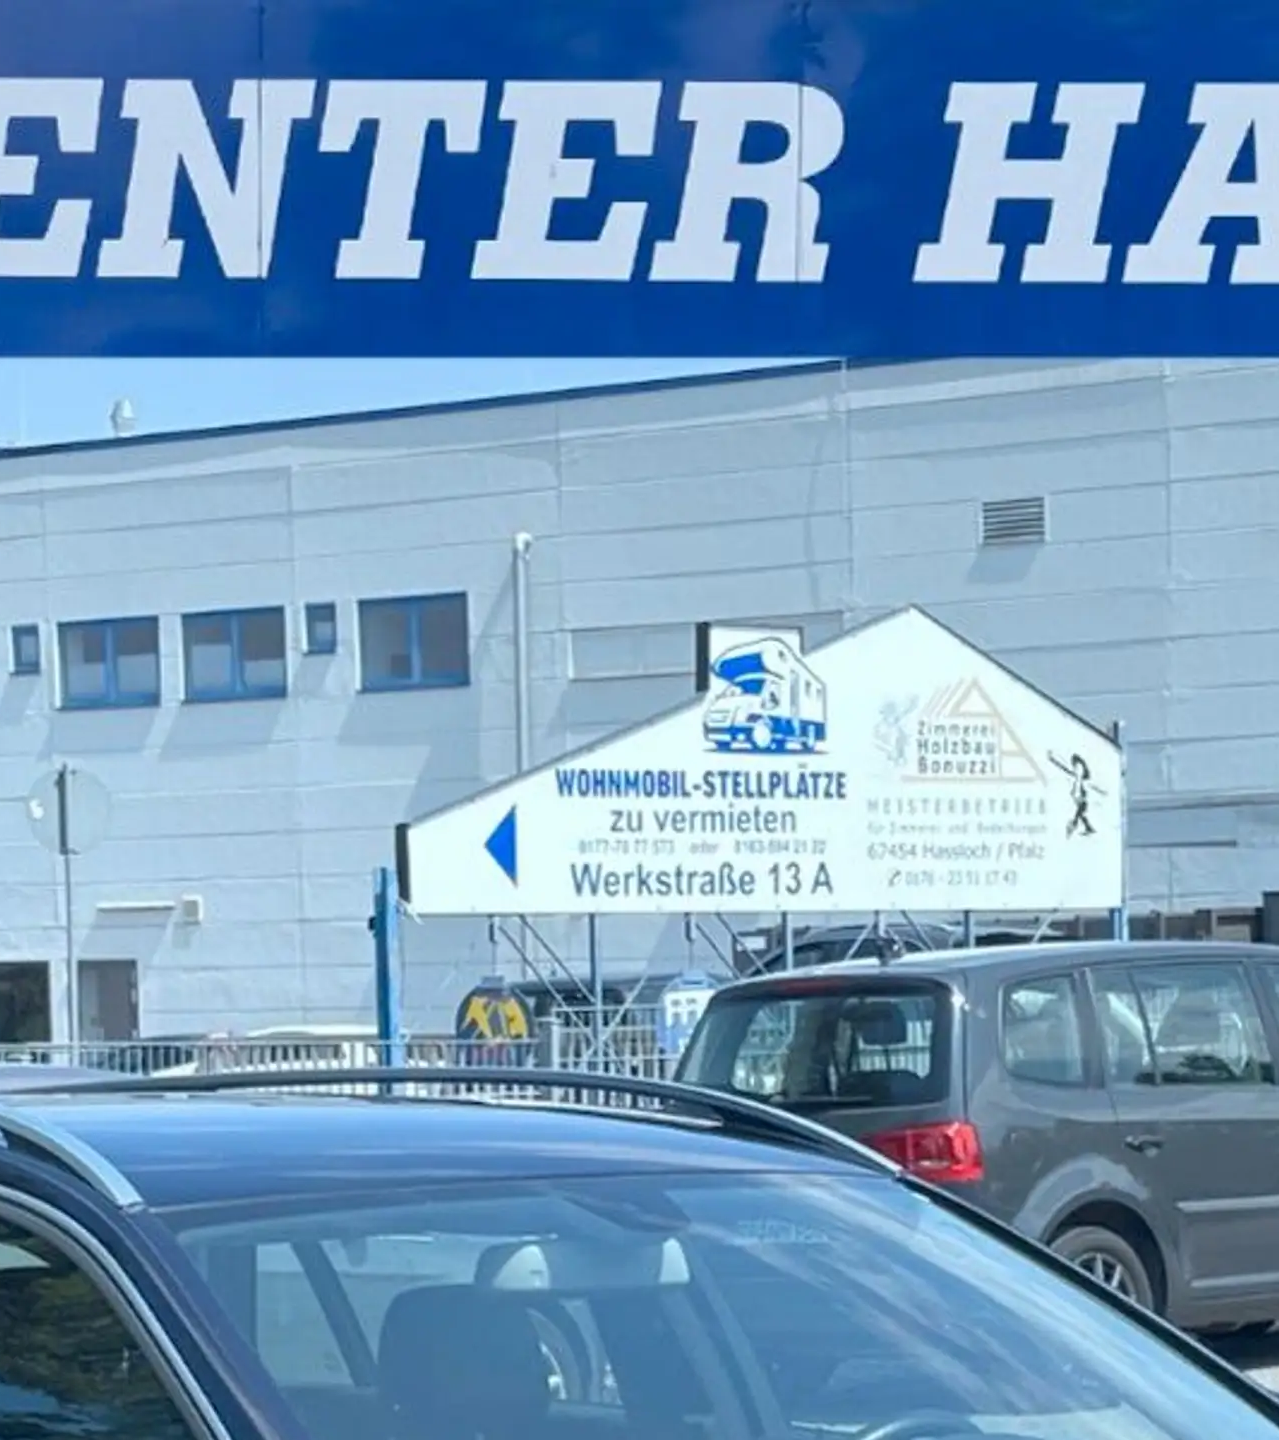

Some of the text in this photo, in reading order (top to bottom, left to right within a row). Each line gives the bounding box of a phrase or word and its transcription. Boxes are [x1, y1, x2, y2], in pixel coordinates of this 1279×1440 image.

[917, 720, 996, 737] Zimmerei
[916, 738, 996, 756] Holzbau
[917, 757, 996, 775] Bonuzzi
[555, 763, 847, 799] WOHNMOBIL-STELLPLÄTZE
[609, 802, 797, 833] zu vermieten
[1007, 841, 1046, 862] Pfalz
[571, 861, 834, 897] Werkstraße 13 A
